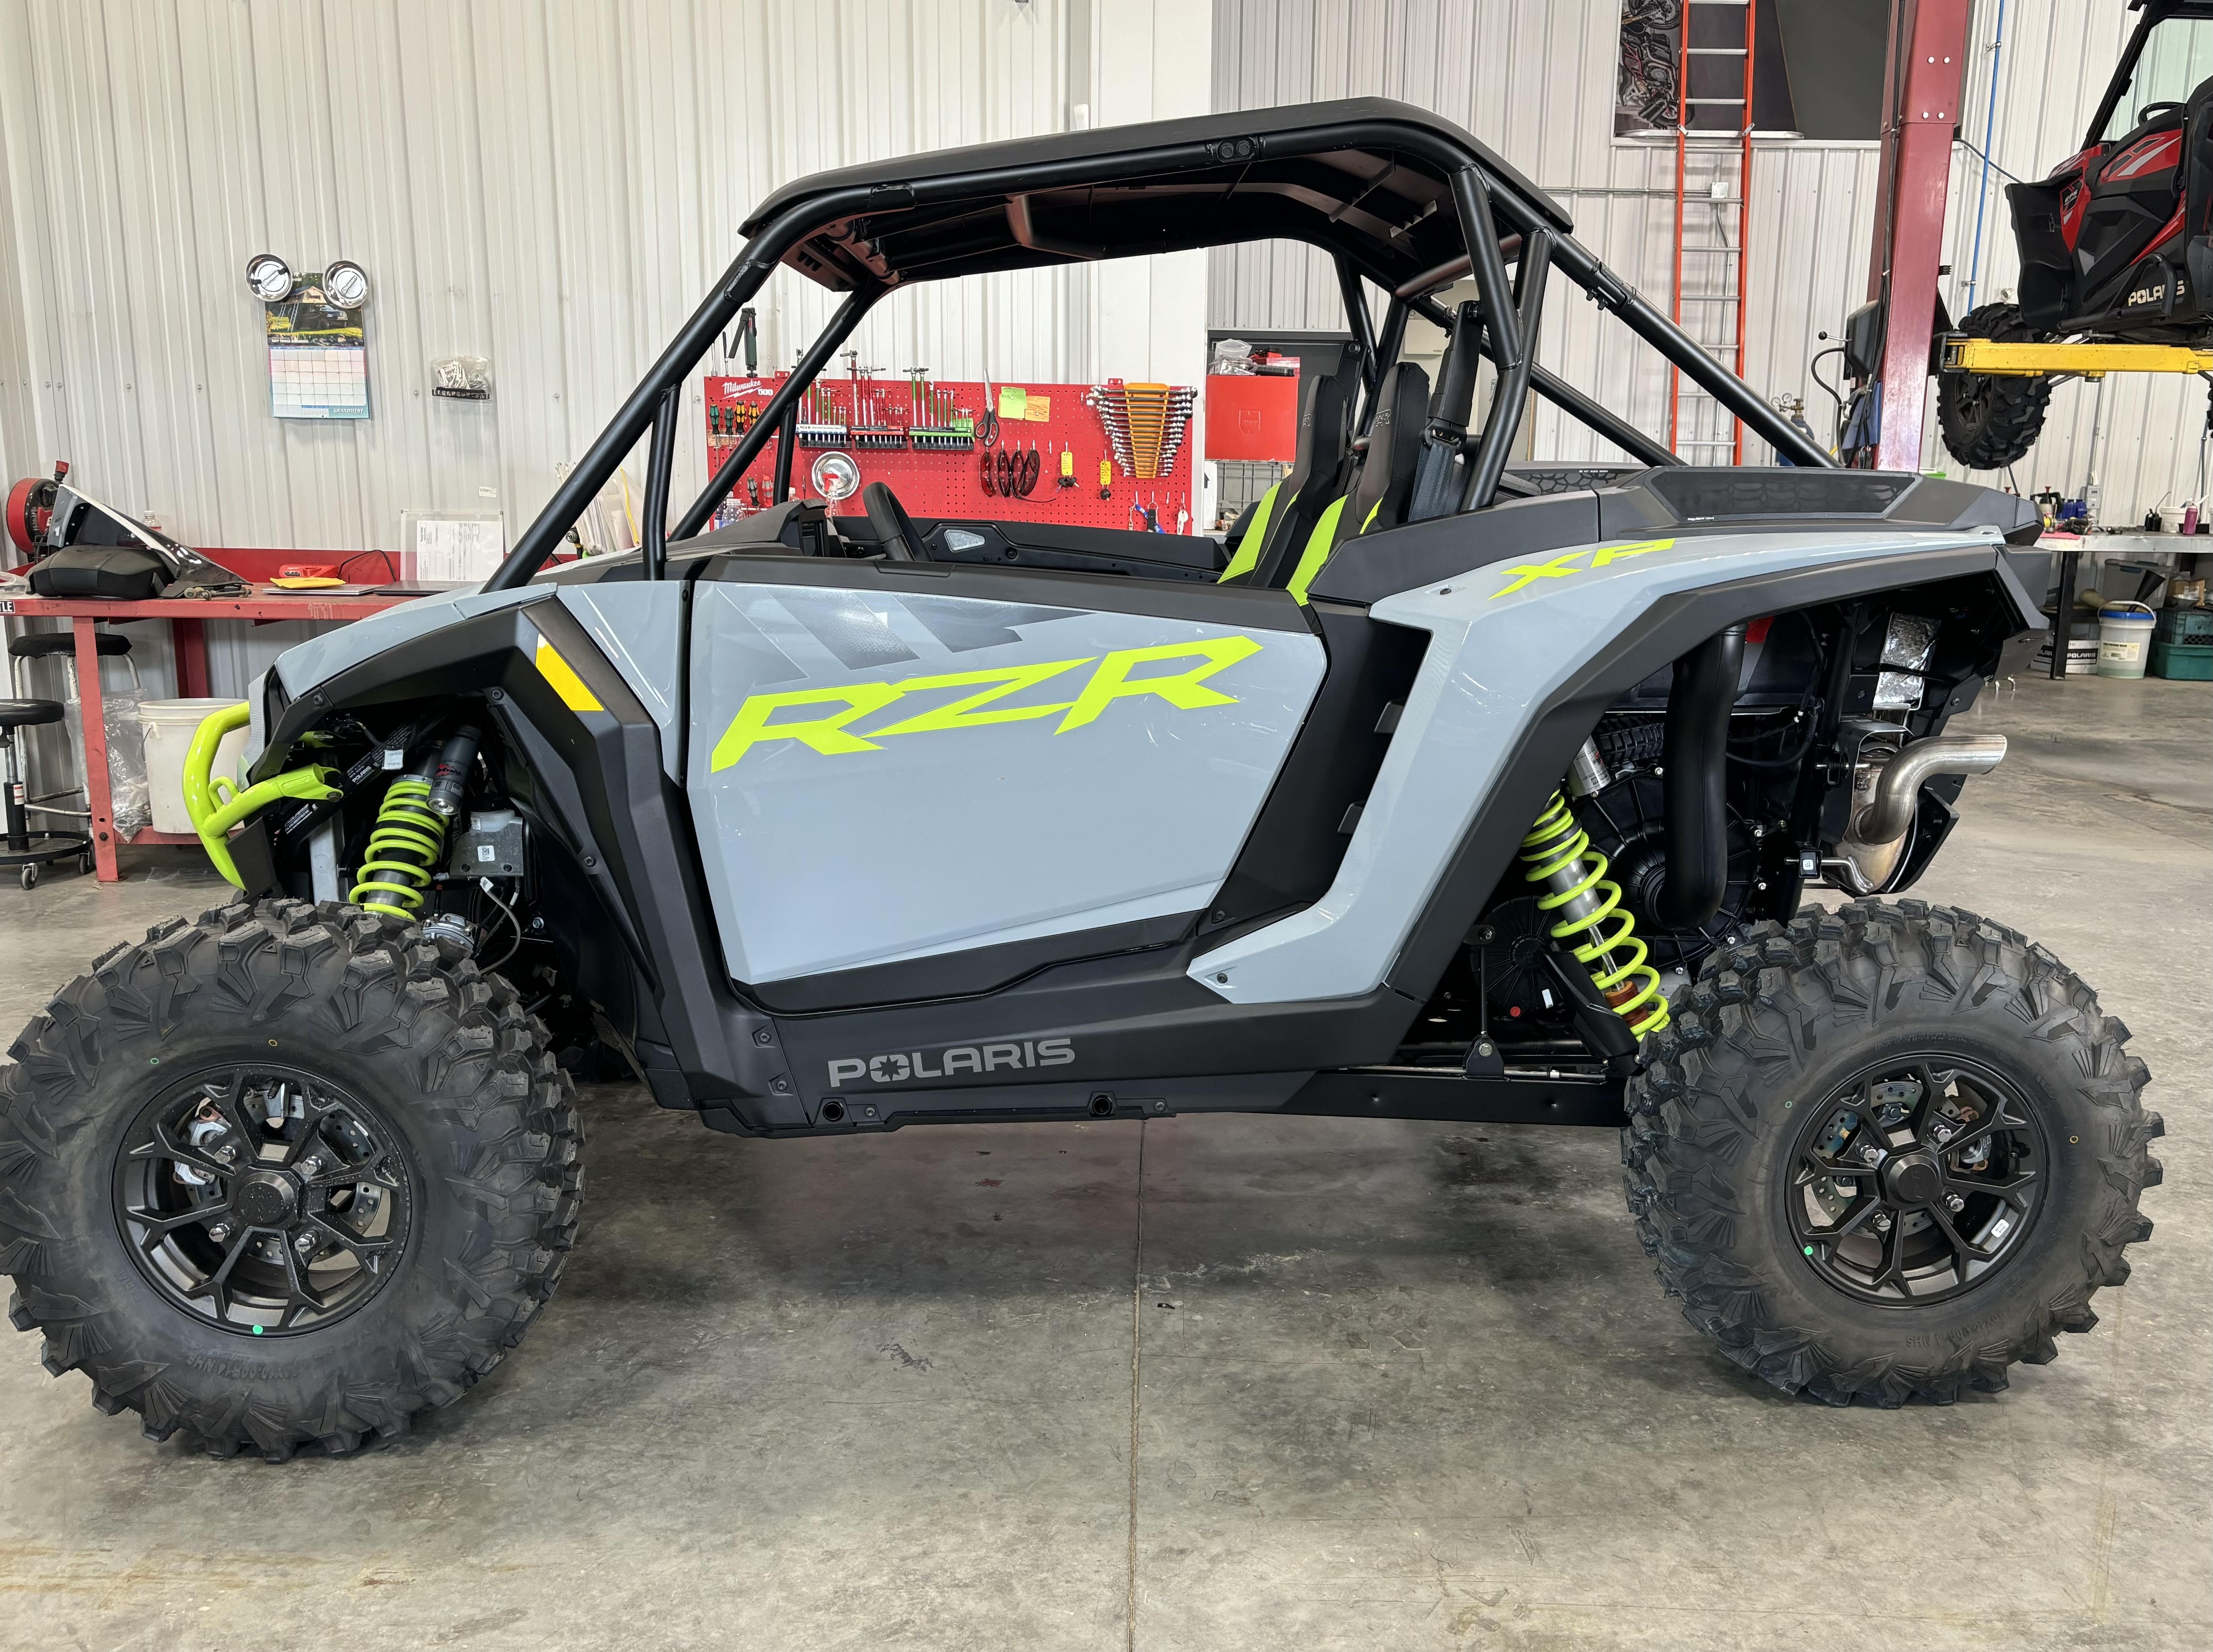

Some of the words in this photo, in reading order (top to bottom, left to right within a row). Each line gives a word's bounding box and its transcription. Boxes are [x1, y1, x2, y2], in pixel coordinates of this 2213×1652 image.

[2128, 280, 2185, 306] POLAS
[721, 379, 762, 395] Milwaukee
[1486, 538, 1676, 600] XP
[711, 635, 1263, 773] RZR
[351, 766, 372, 783] POLARIS
[827, 1037, 1075, 1087] POLARIS
